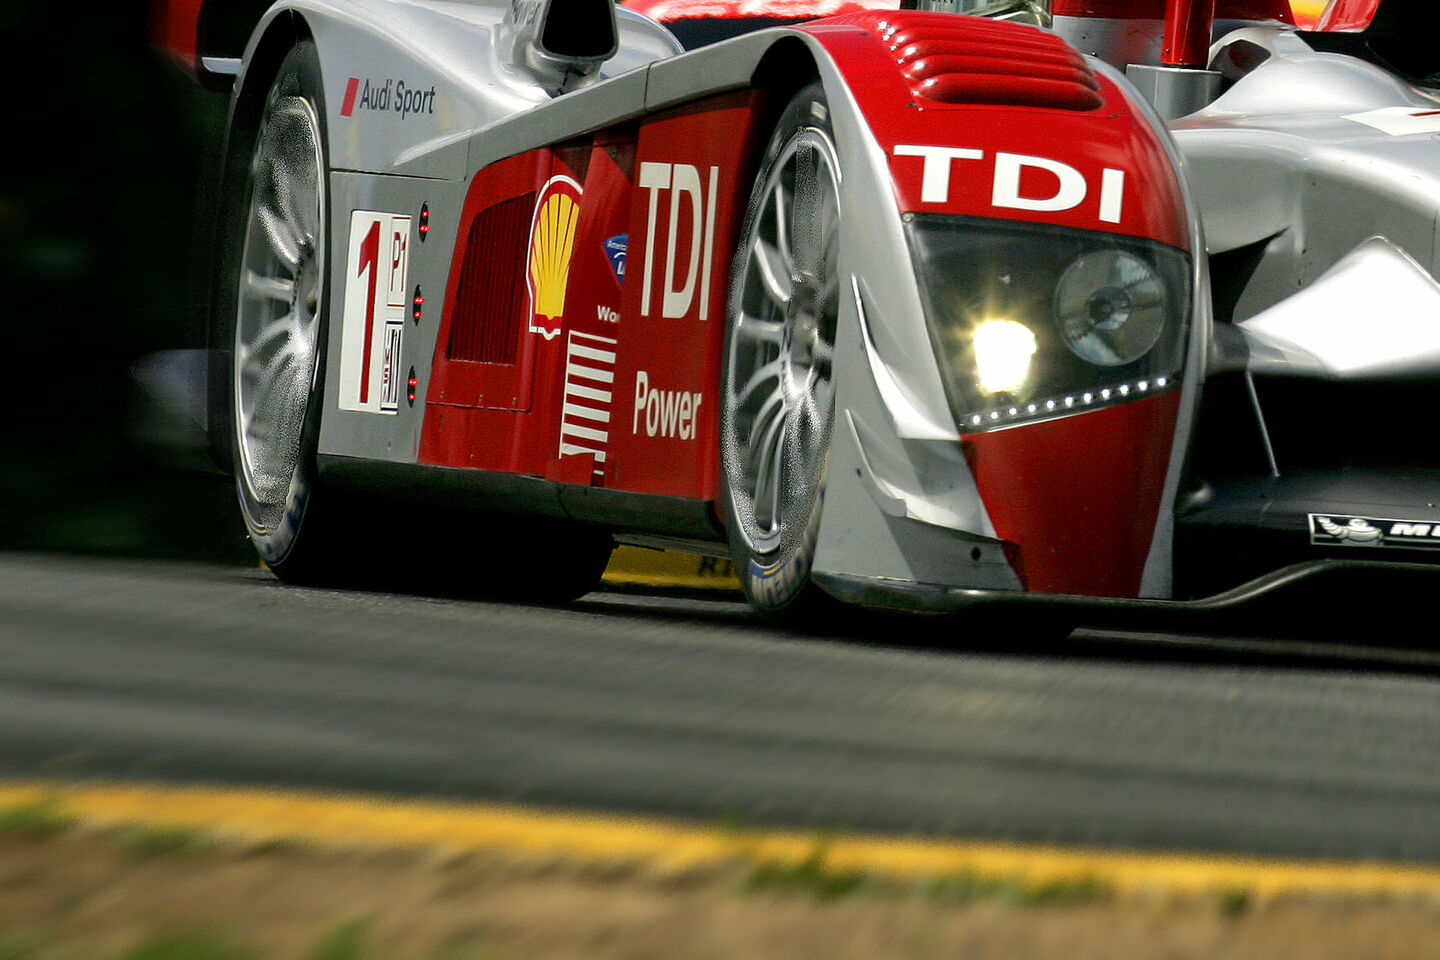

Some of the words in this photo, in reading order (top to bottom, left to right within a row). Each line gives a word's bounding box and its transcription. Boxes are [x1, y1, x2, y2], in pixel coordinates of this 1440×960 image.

[359, 78, 393, 111] Audi
[394, 79, 436, 120] Sport
[893, 144, 1125, 224] TDI
[390, 231, 407, 292] P1
[638, 161, 719, 321] TDI
[358, 221, 381, 404] 1
[632, 370, 702, 441] Power
